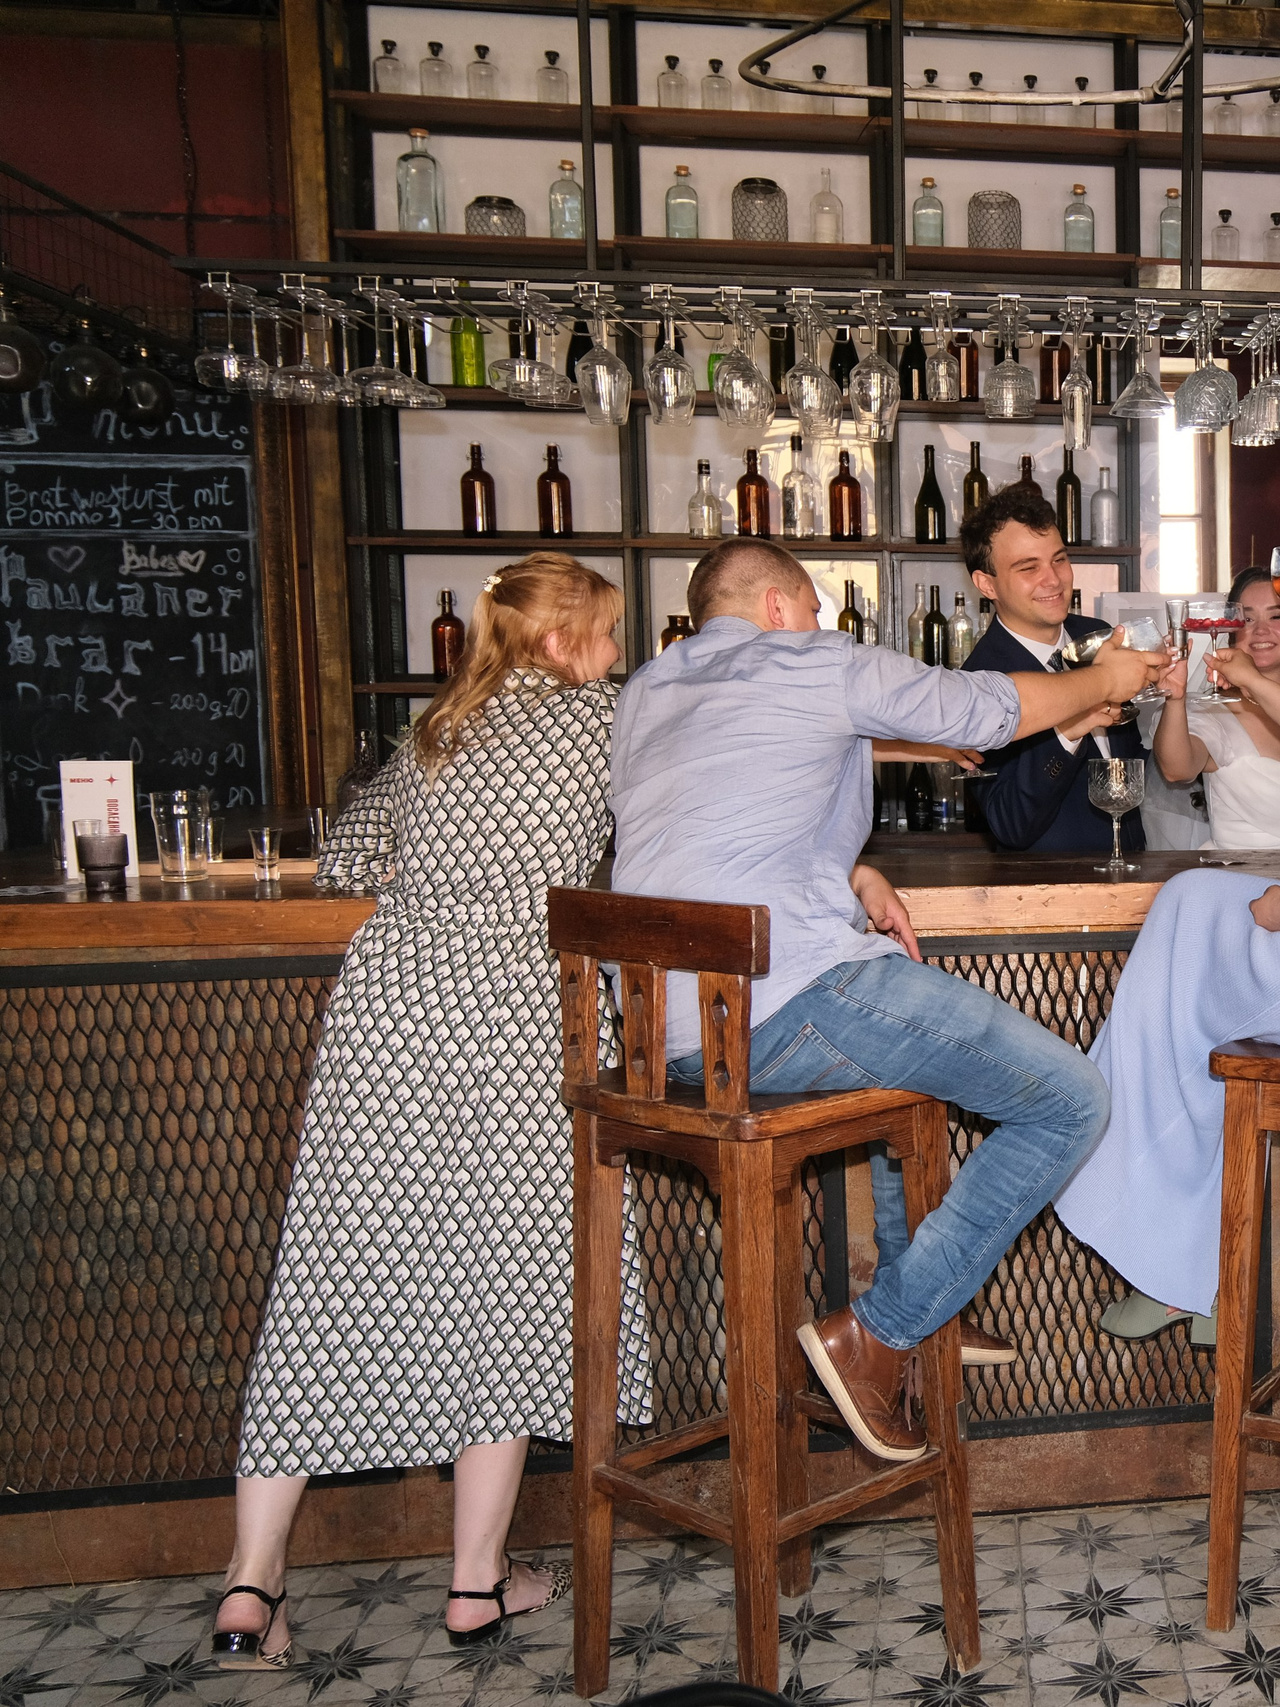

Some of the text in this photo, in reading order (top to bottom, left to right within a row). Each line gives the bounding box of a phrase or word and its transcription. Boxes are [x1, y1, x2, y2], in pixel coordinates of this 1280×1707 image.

[193, 476, 233, 508] mit
[150, 512, 179, 531] 30
[106, 798, 121, 834] ПОСЛЕДНЯ
